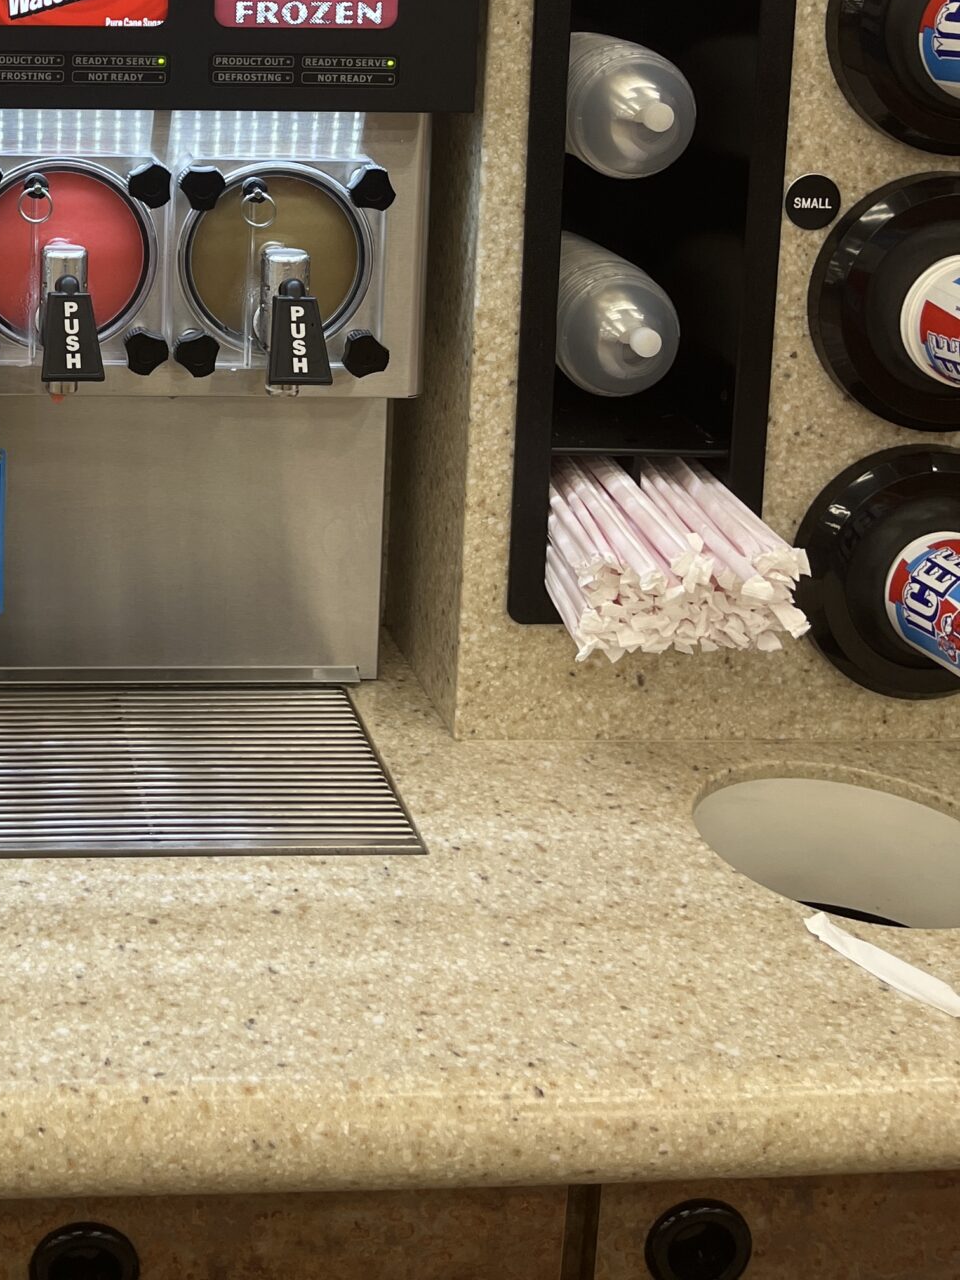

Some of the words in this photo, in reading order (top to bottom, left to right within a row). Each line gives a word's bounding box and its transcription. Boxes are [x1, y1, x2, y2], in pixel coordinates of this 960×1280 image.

[235, 1, 383, 26] FROZEN
[35, 57, 55, 65] OUT
[75, 57, 108, 65] READY
[111, 57, 123, 65] TO
[126, 58, 158, 66] SERVE
[215, 57, 262, 65] PRODUCT
[265, 58, 284, 66] OUT
[305, 58, 337, 66] READY
[341, 59, 353, 67] TO
[356, 59, 387, 67] SERVE
[89, 73, 108, 81] NOT
[111, 73, 143, 81] READY
[218, 73, 281, 82] DEFROSTING
[317, 74, 337, 82] NOT
[341, 74, 372, 82] READY
[793, 197, 833, 210] SMALL
[64, 301, 82, 370] PUSH
[290, 306, 308, 374] PUSH
